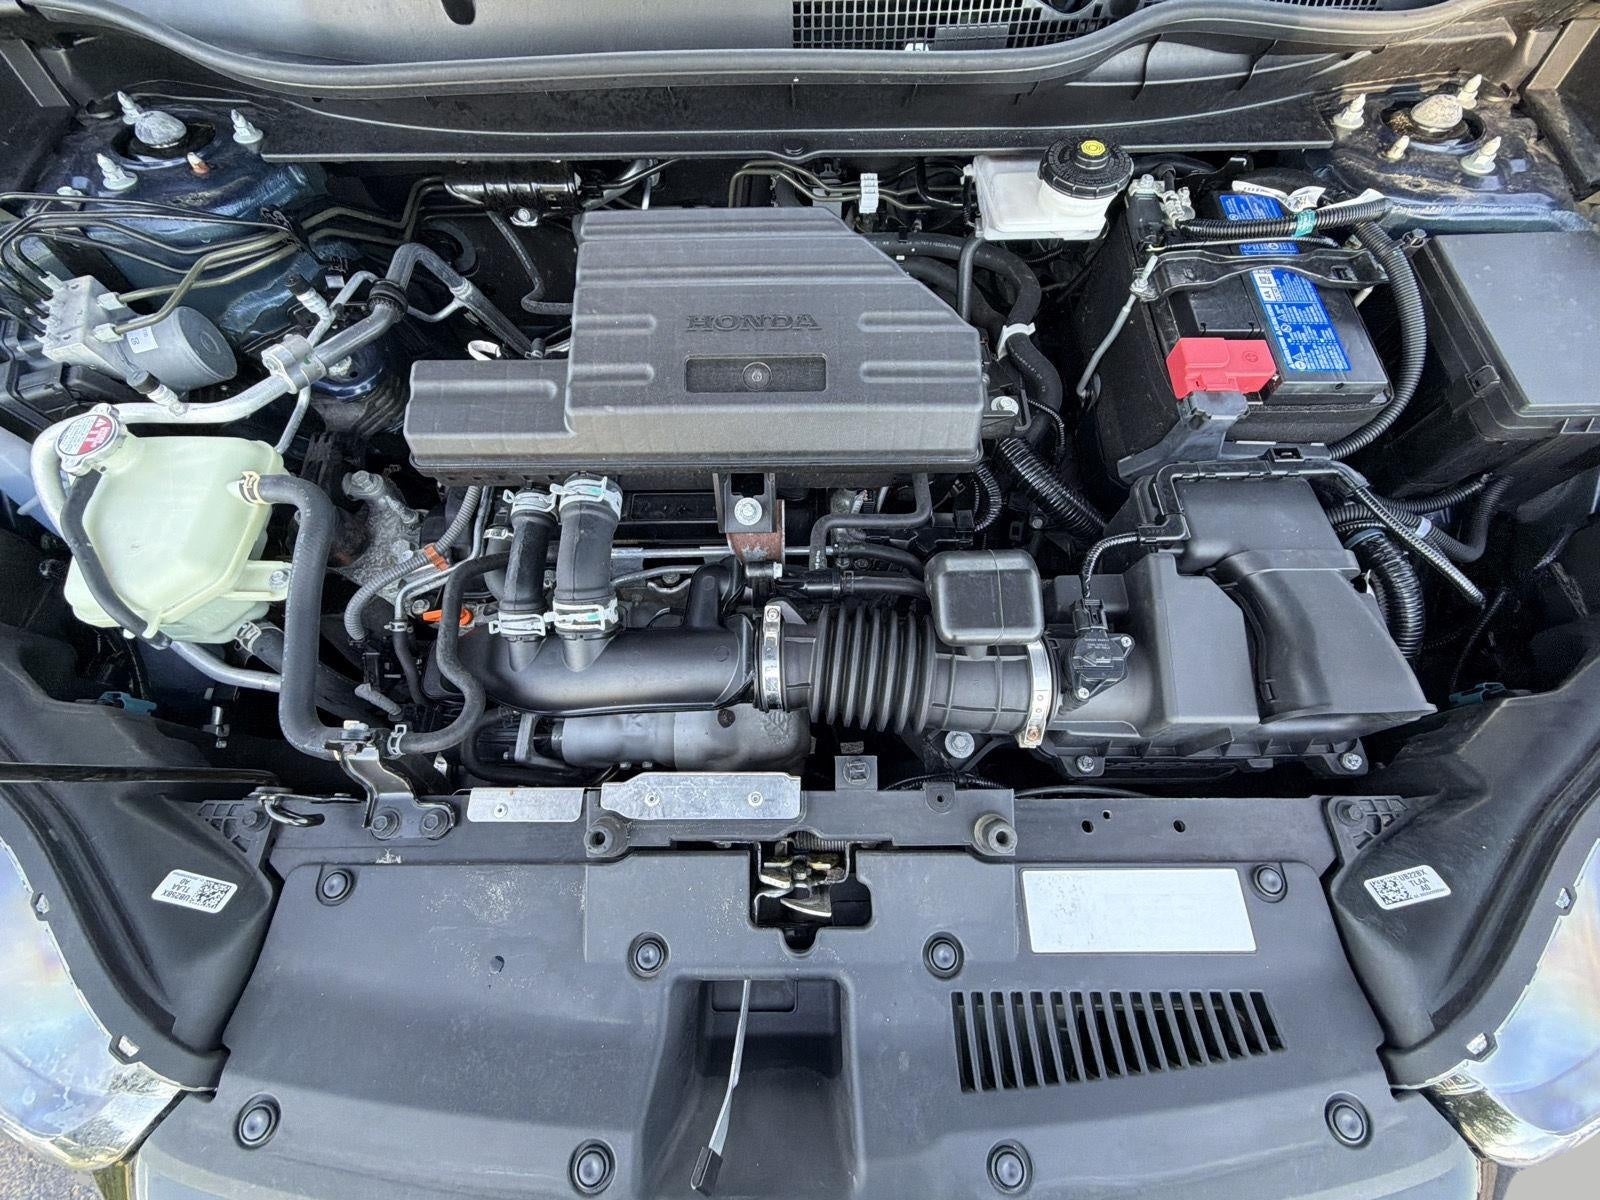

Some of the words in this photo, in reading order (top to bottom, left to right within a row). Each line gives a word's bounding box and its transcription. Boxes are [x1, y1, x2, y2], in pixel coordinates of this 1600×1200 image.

[687, 313, 823, 332] HONDA
[1408, 877, 1430, 887] TLAA
[171, 883, 190, 893] TLAA
